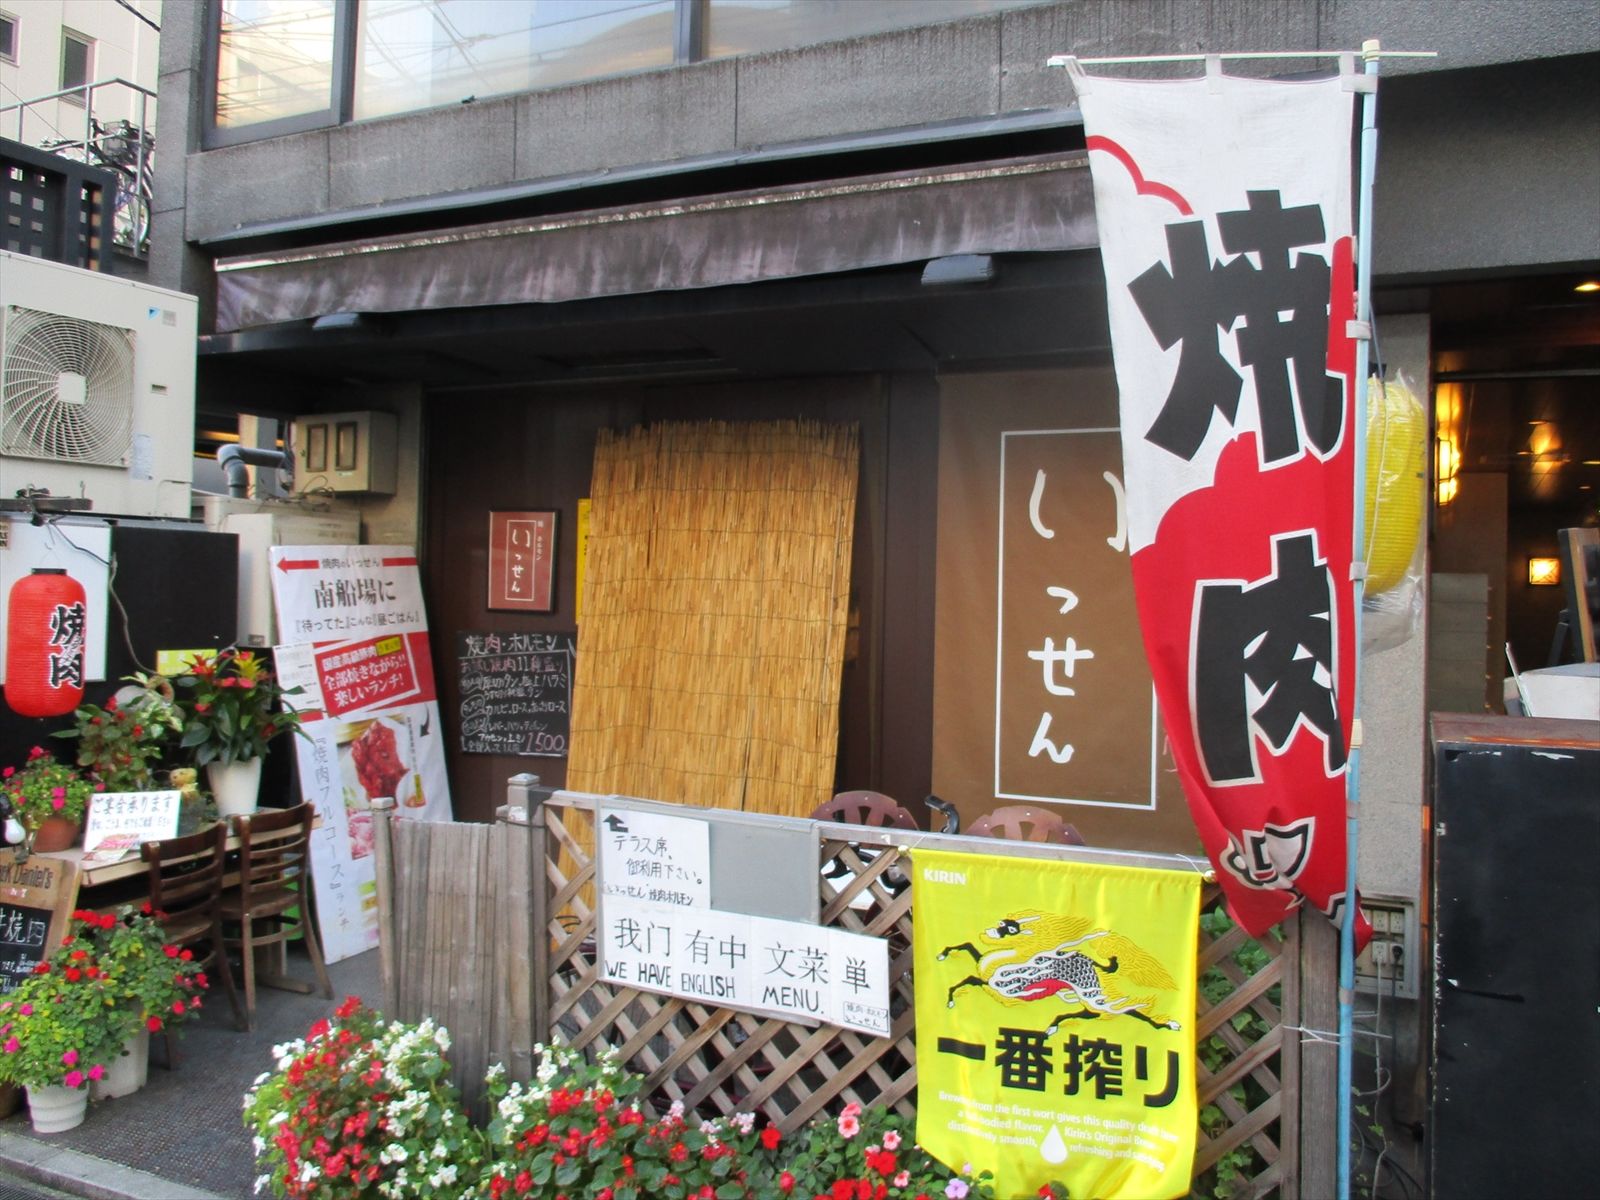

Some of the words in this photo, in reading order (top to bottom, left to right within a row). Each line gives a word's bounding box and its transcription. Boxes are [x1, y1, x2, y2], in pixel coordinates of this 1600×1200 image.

[1126, 188, 1348, 774] 焼肉
[511, 528, 530, 593] いっせん
[312, 577, 397, 610] 南船場に
[1028, 468, 1128, 765] いっせん
[50, 601, 86, 688] 焼肉
[334, 673, 405, 708] 楽しいランチ!
[613, 834, 674, 860] テラス席、
[13, 863, 53, 890] Daniel's
[923, 868, 967, 886] KIRIN
[604, 960, 628, 979] WE
[637, 962, 672, 988] HAVE
[681, 972, 736, 999] ENGLISH
[937, 1027, 1180, 1107] 一番搾り
[994, 1103, 1010, 1114] the
[1012, 1103, 1031, 1116] first
[1032, 1109, 1055, 1120] wort
[1057, 1112, 1081, 1124] gives
[1083, 1114, 1101, 1126] this
[1103, 1118, 1137, 1132] quality
[1014, 1118, 1043, 1133] flavor.
[1064, 1125, 1092, 1140] Kirin's
[1094, 1131, 1131, 1145] Original
